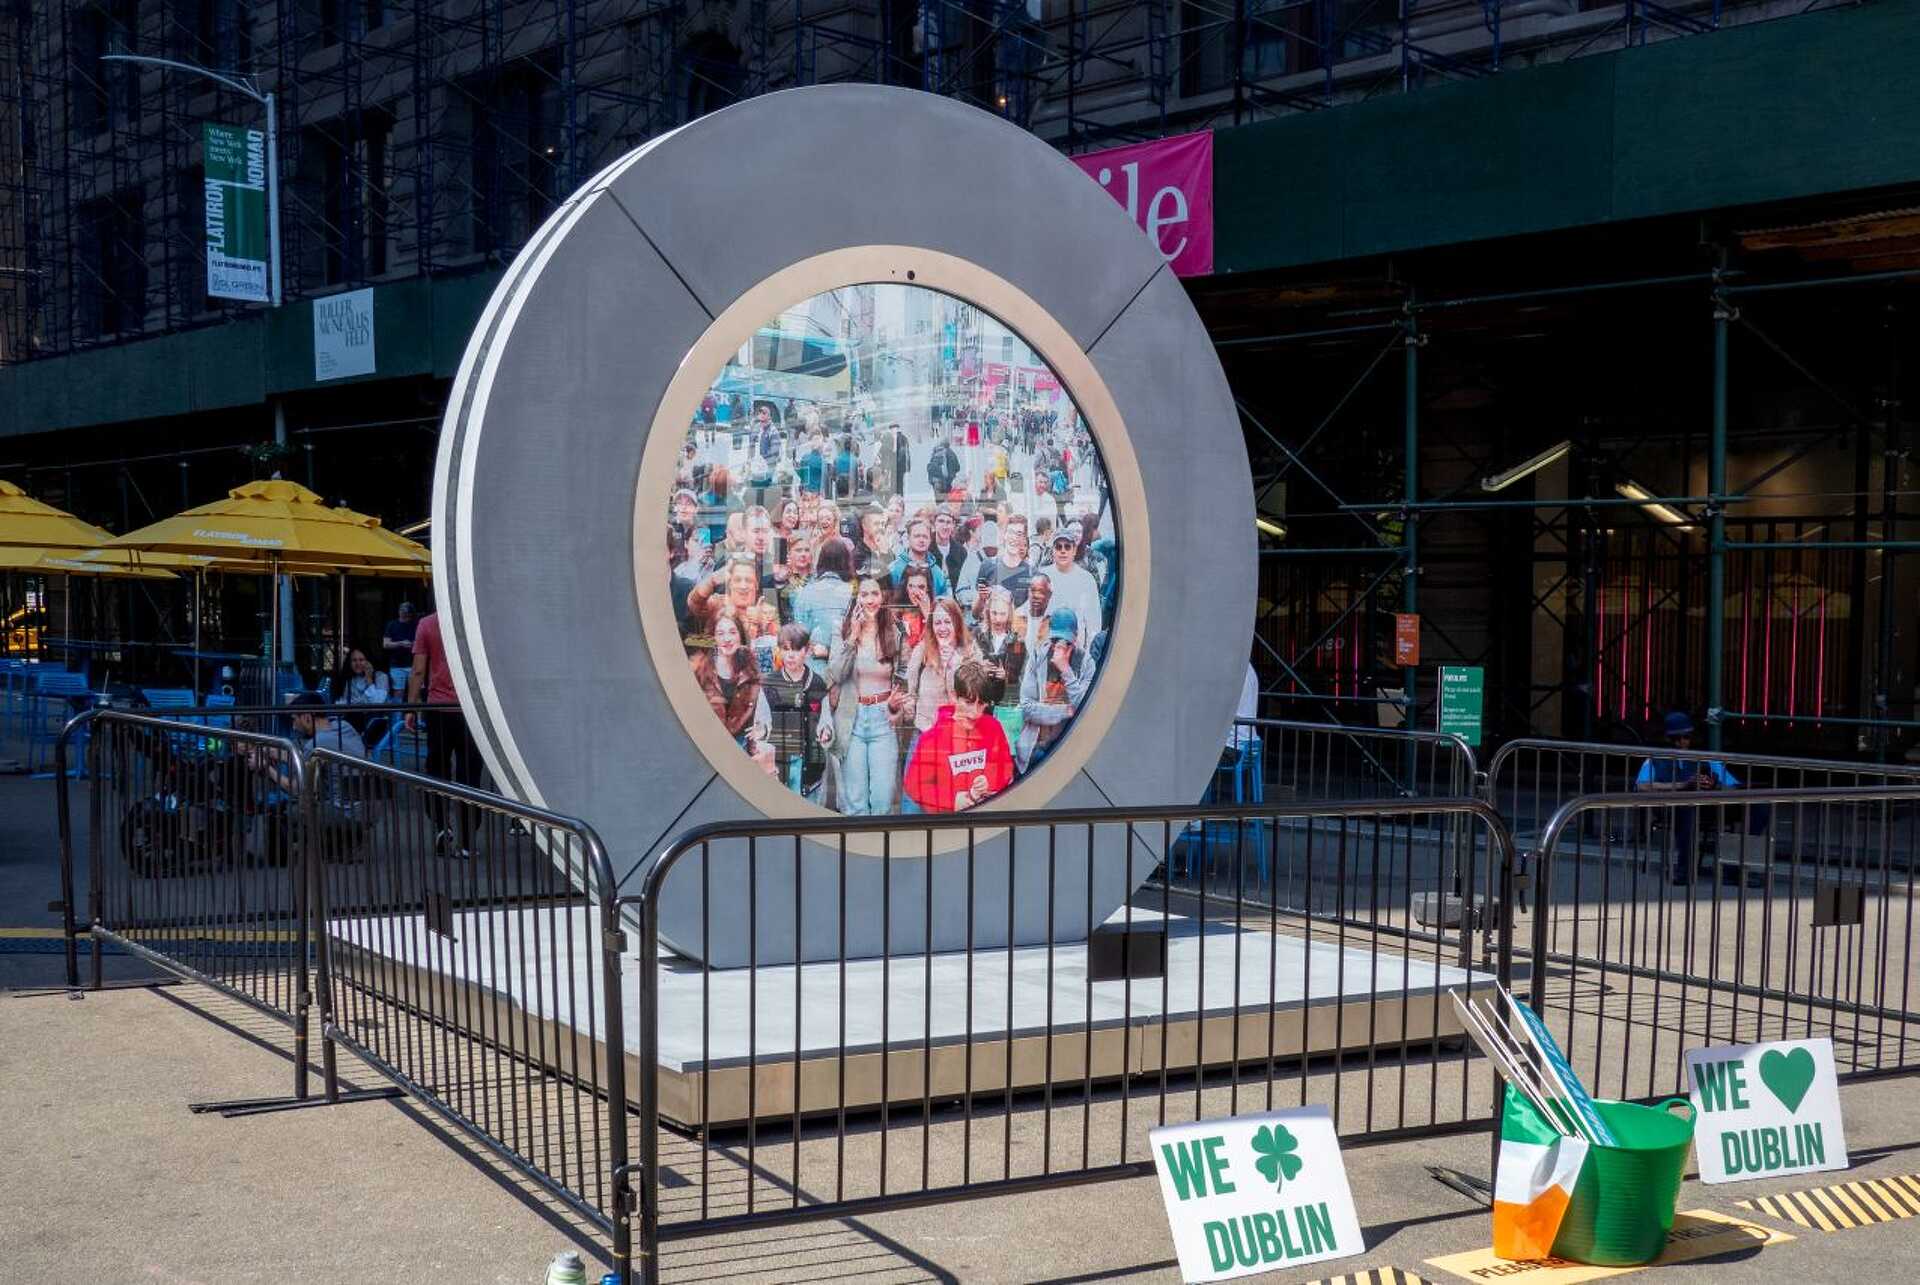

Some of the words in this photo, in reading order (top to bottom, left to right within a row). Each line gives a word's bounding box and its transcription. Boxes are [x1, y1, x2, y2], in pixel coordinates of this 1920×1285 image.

[247, 129, 265, 191] NOMAD
[205, 178, 225, 254] FLATIRON
[1693, 1059, 1750, 1113] WE
[1160, 1135, 1237, 1201] WE
[1720, 1122, 1826, 1176] DUBLIN
[1203, 1201, 1338, 1273] DUBLIN
